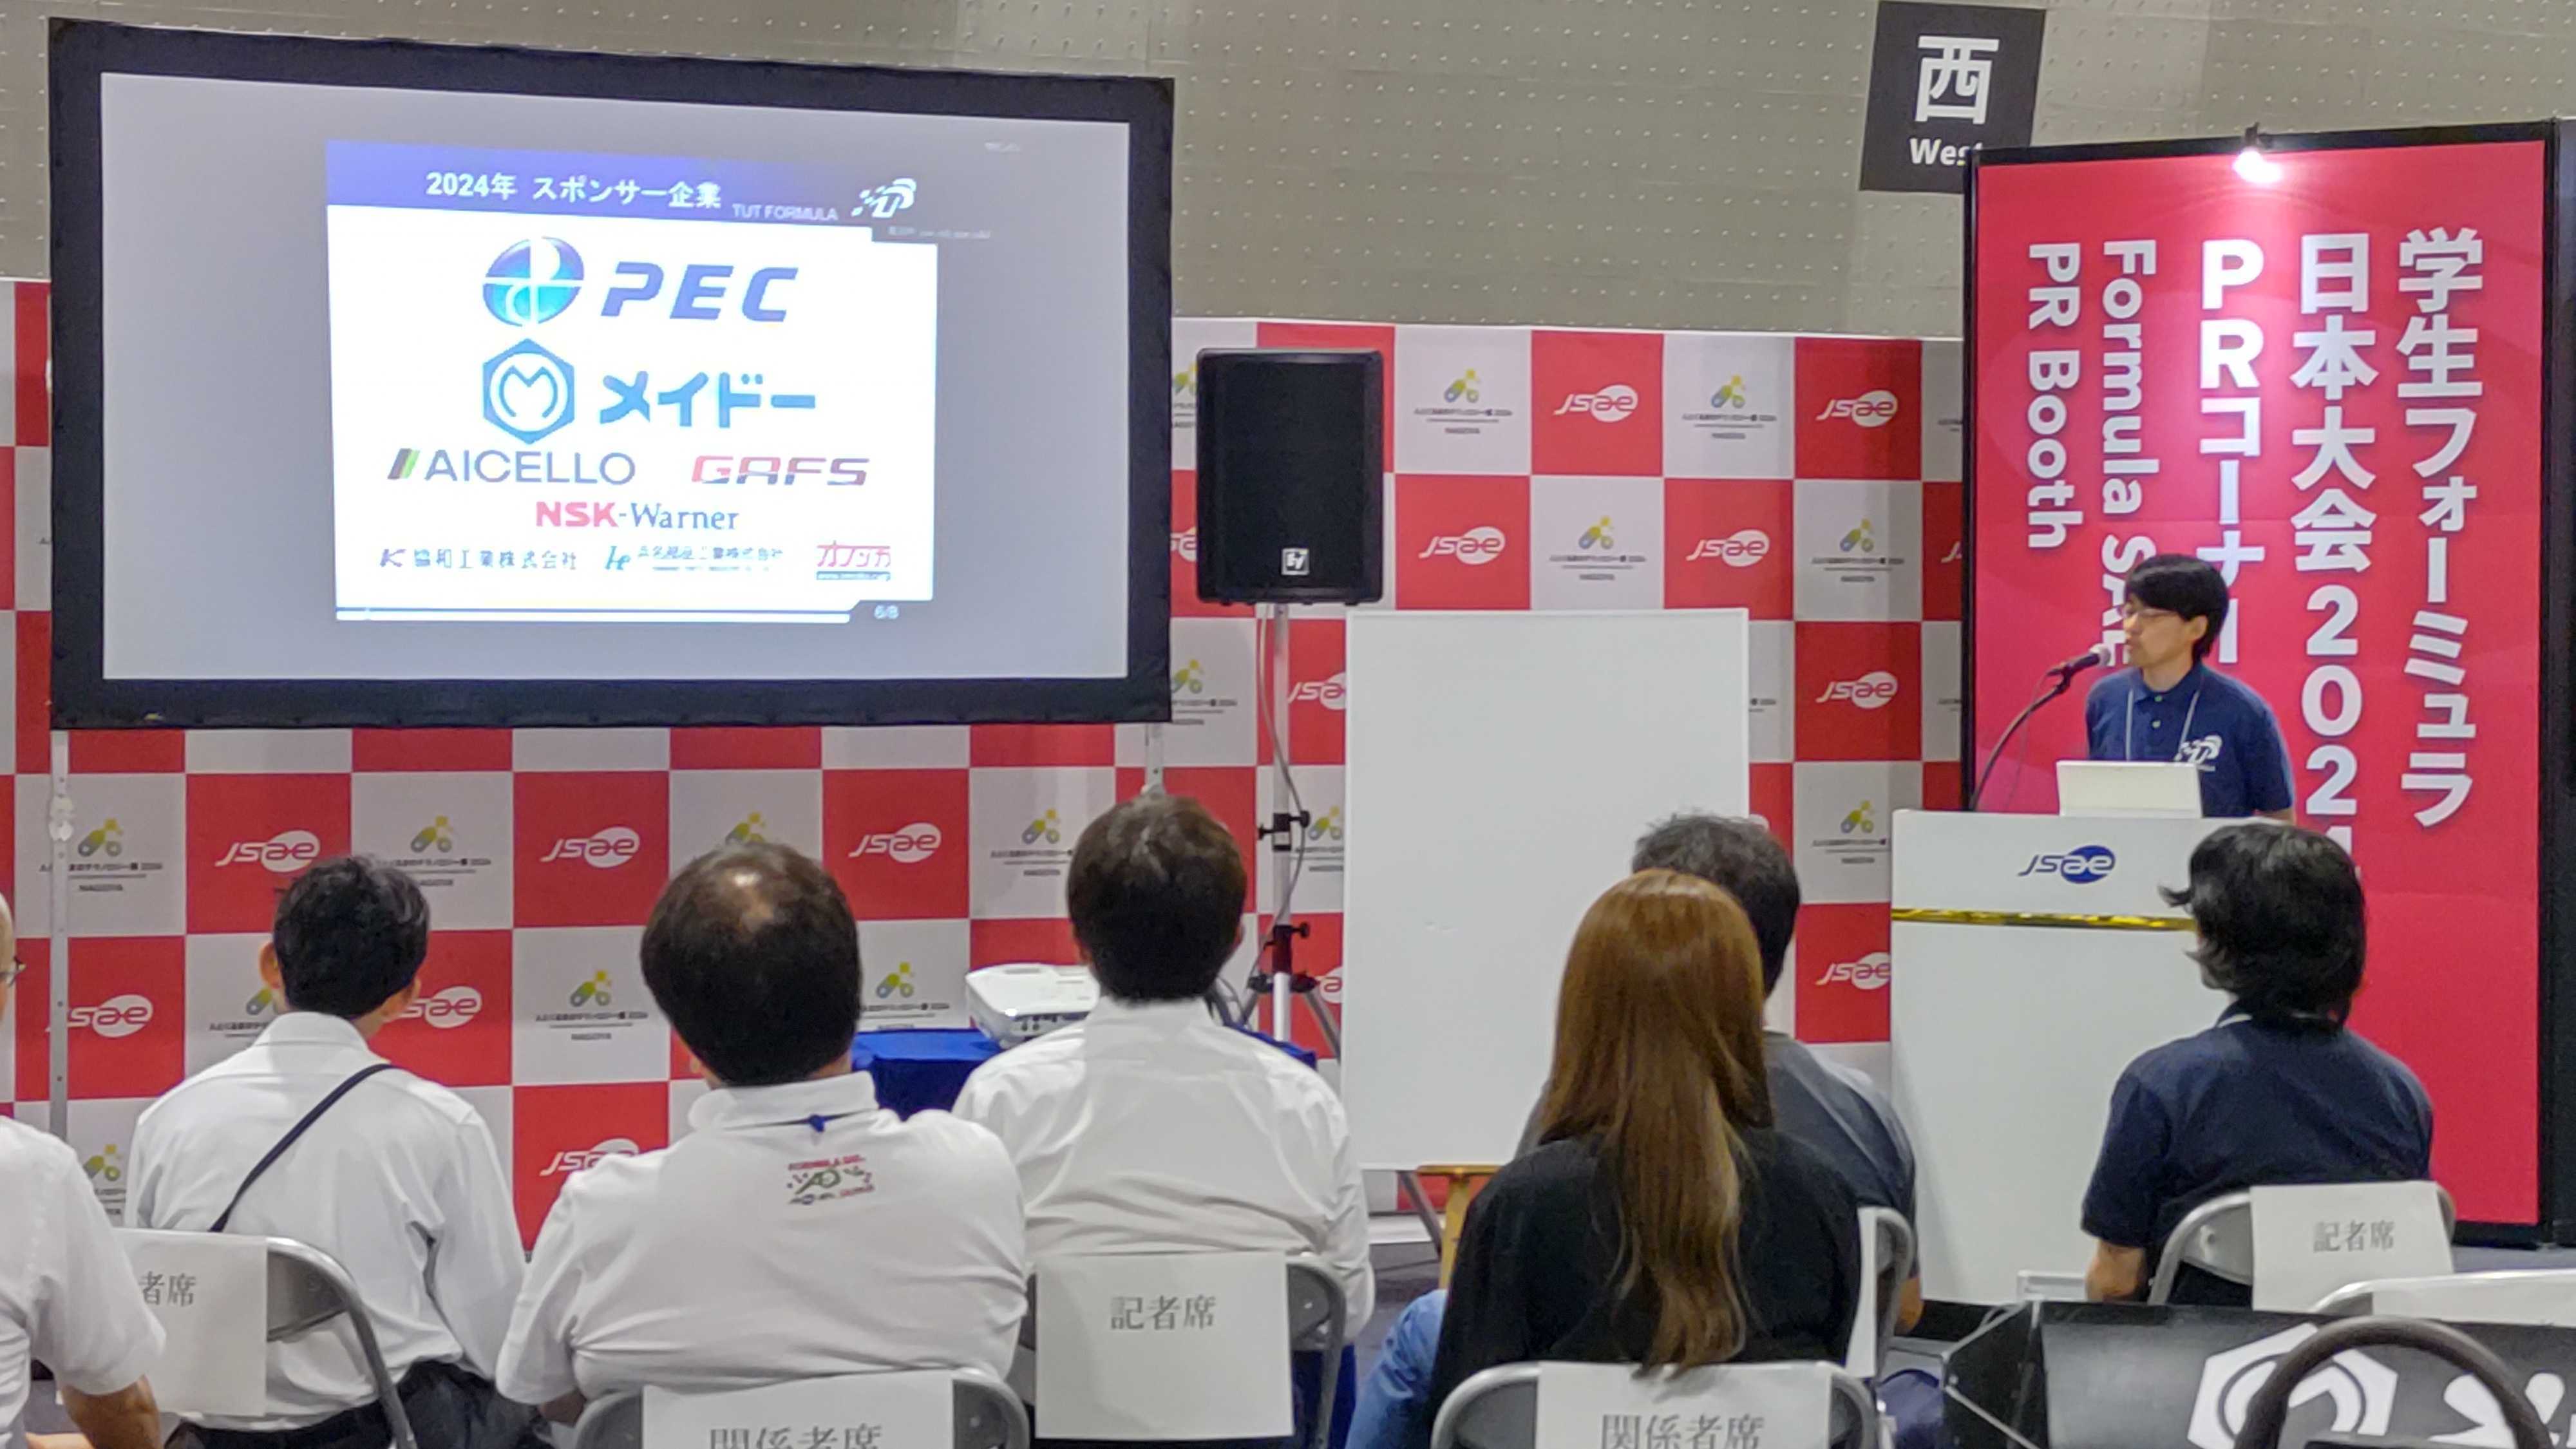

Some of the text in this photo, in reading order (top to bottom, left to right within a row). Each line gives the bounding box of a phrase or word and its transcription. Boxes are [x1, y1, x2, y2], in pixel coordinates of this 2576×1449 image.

[1915, 35, 2000, 124] 西
[1909, 138, 1983, 166] Wes
[426, 172, 722, 209] 2024年 スポンサー企業
[732, 203, 838, 221] TUT FORMULA
[600, 260, 799, 323] PEC
[2027, 242, 2084, 549] PR Booth
[2102, 239, 2159, 515] Formula
[599, 370, 816, 429] メイドー
[424, 450, 636, 485] AICELLO
[691, 455, 869, 486] GAFS
[536, 501, 741, 531] NSK-Warner
[2396, 227, 2483, 828] 学生フォーミュラ
[2312, 1218, 2396, 1254] 記者席
[137, 1270, 197, 1307] 者席
[1110, 1294, 1217, 1331] 記者席
